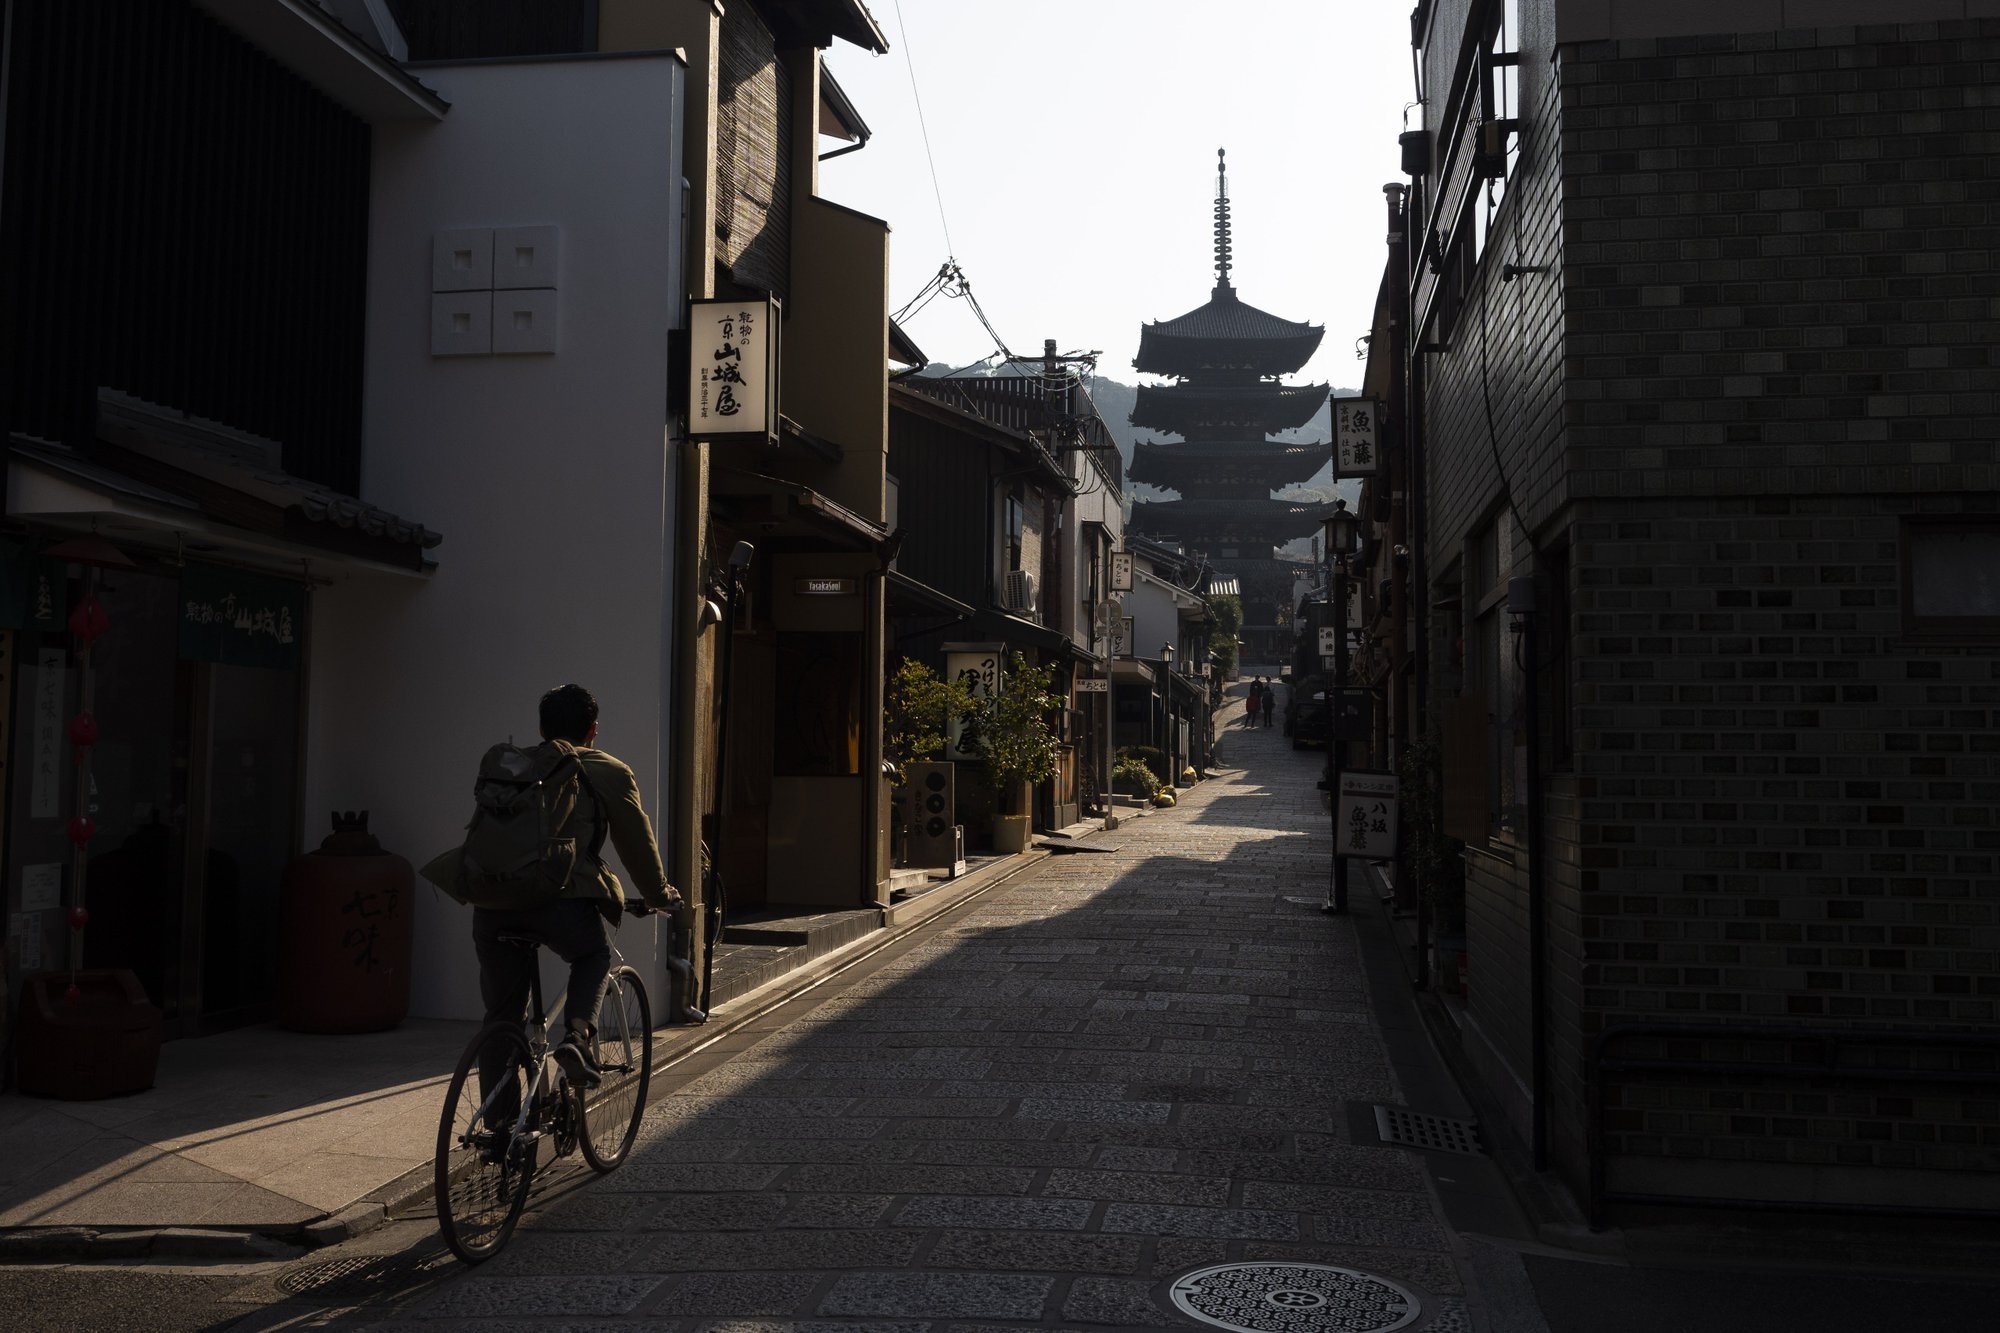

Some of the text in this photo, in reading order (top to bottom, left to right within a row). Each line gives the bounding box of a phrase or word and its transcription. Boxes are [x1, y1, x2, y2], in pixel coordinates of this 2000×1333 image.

[739, 311, 754, 346] 乾物の
[1370, 801, 1388, 834] 八坂
